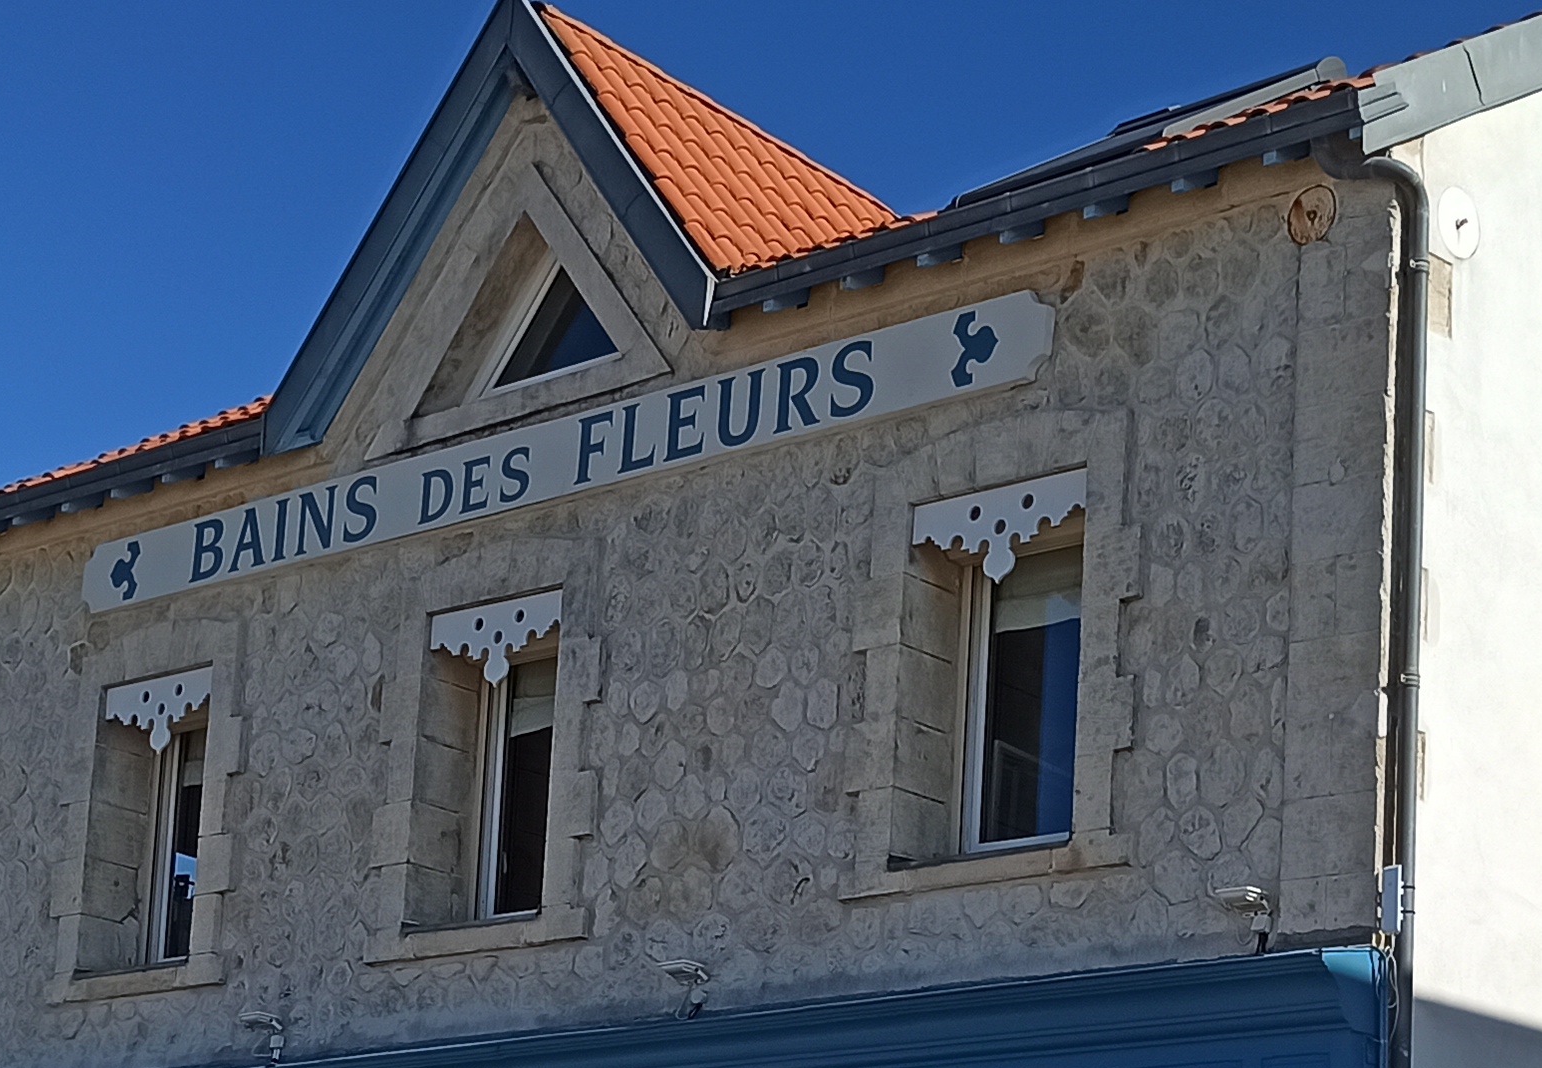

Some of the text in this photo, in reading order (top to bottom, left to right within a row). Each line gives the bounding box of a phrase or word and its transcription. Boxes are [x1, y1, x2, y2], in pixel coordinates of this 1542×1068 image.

[188, 340, 875, 584] BAINS DES FLEURS
